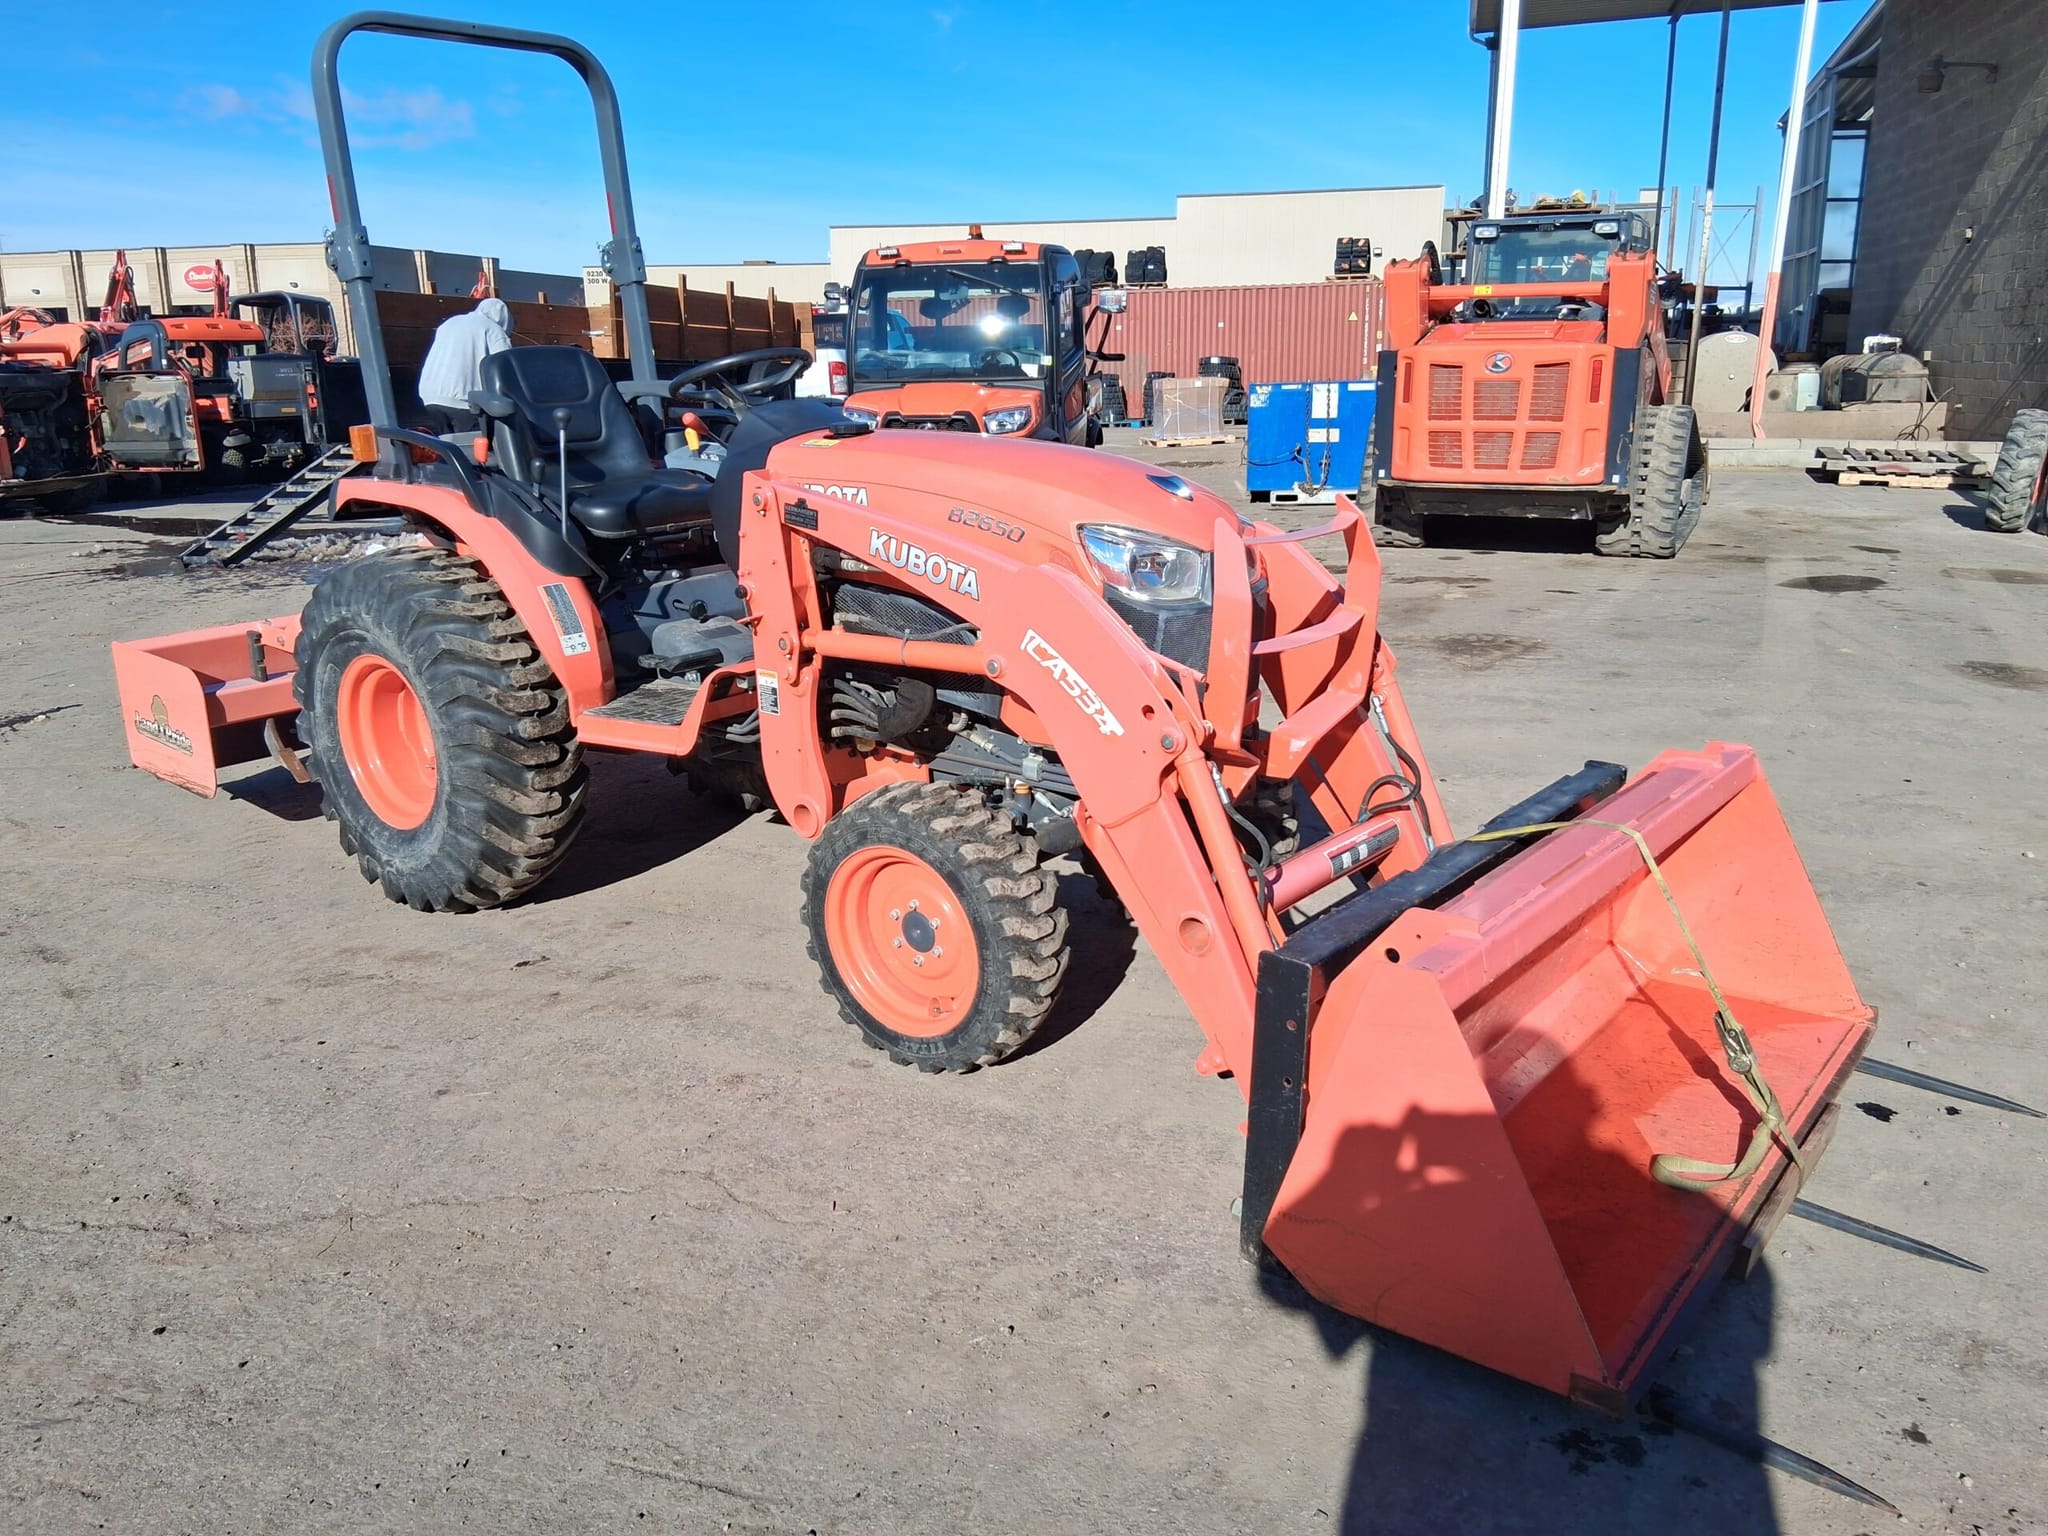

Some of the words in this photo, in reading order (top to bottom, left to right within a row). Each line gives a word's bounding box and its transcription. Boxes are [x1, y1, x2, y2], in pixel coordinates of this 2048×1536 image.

[587, 277, 600, 285] 300
[947, 506, 1026, 543] B2650
[868, 526, 981, 601] KUBOTA
